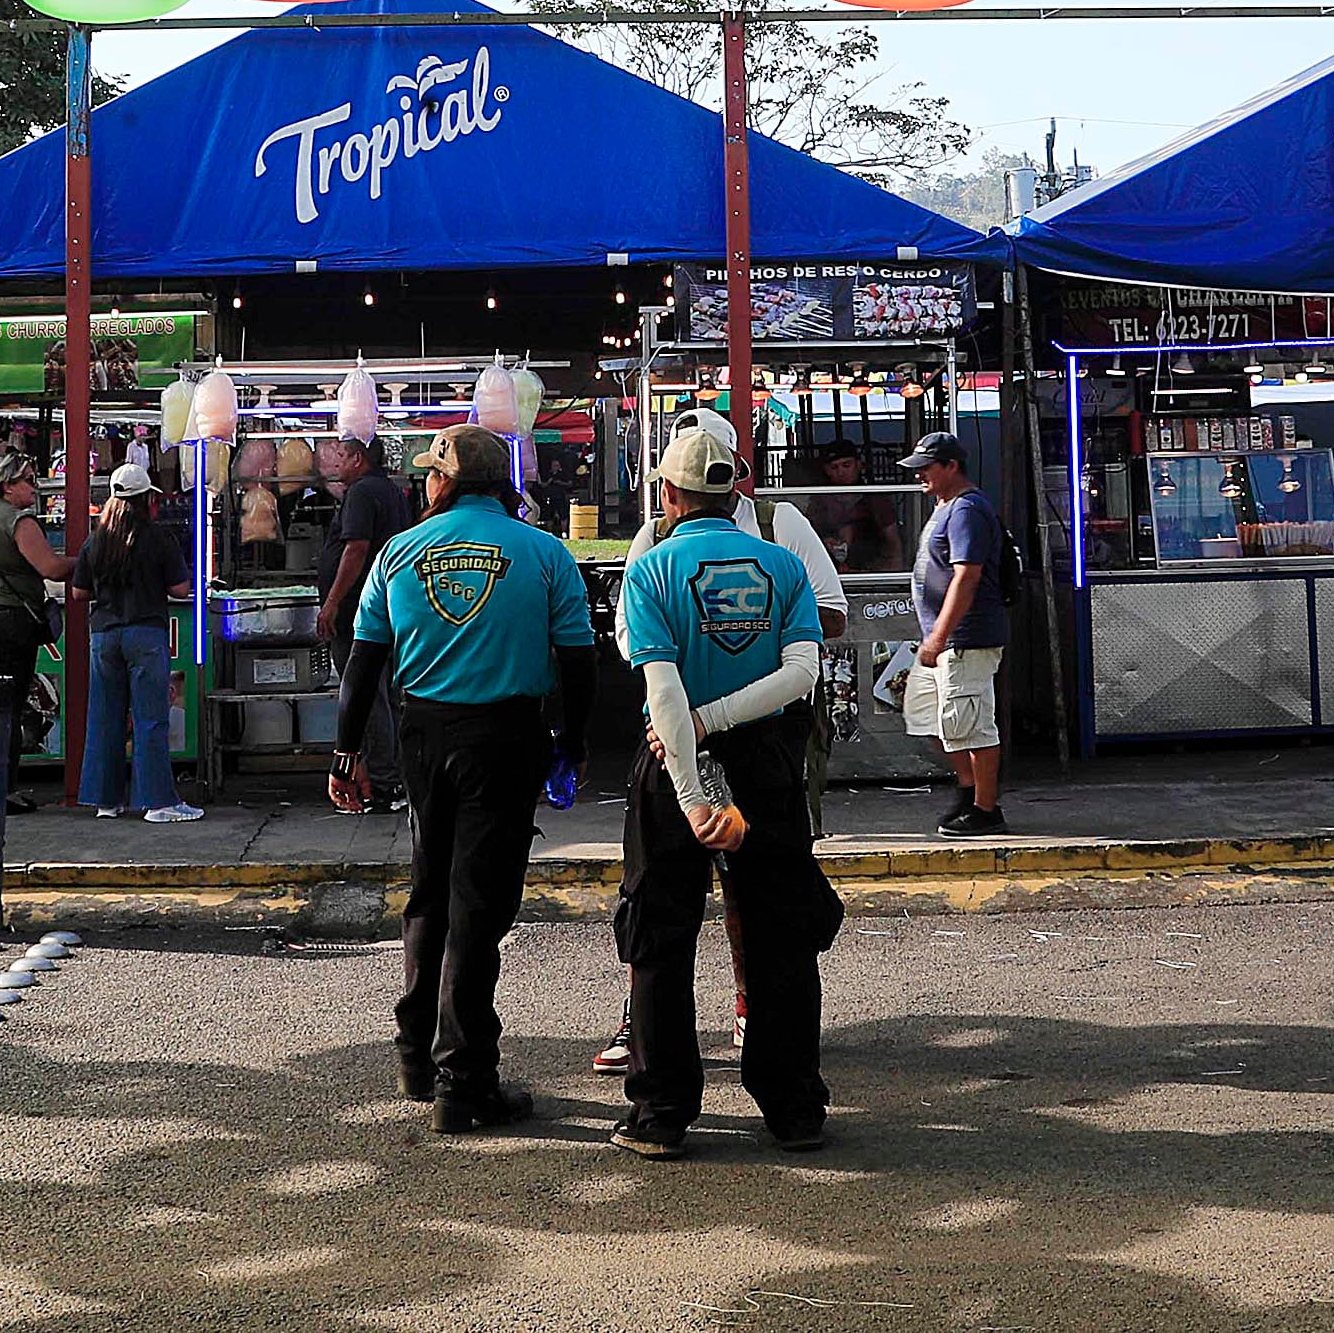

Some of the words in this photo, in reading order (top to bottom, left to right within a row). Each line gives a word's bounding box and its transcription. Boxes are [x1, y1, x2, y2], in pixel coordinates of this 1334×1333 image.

[255, 45, 502, 224] Tropical
[706, 267, 788, 280] PIHOS
[793, 266, 816, 278] DE
[822, 265, 856, 277] RES
[7, 321, 67, 340] CHURRO
[89, 316, 176, 337] RREGLADOS
[1108, 318, 1150, 343] TEL:
[1155, 313, 1251, 342] 6223-7271
[421, 557, 502, 574] SEGURIDAD
[438, 576, 475, 602] SCC
[700, 621, 751, 633] SEGURIDAD
[751, 620, 771, 631] SCC
